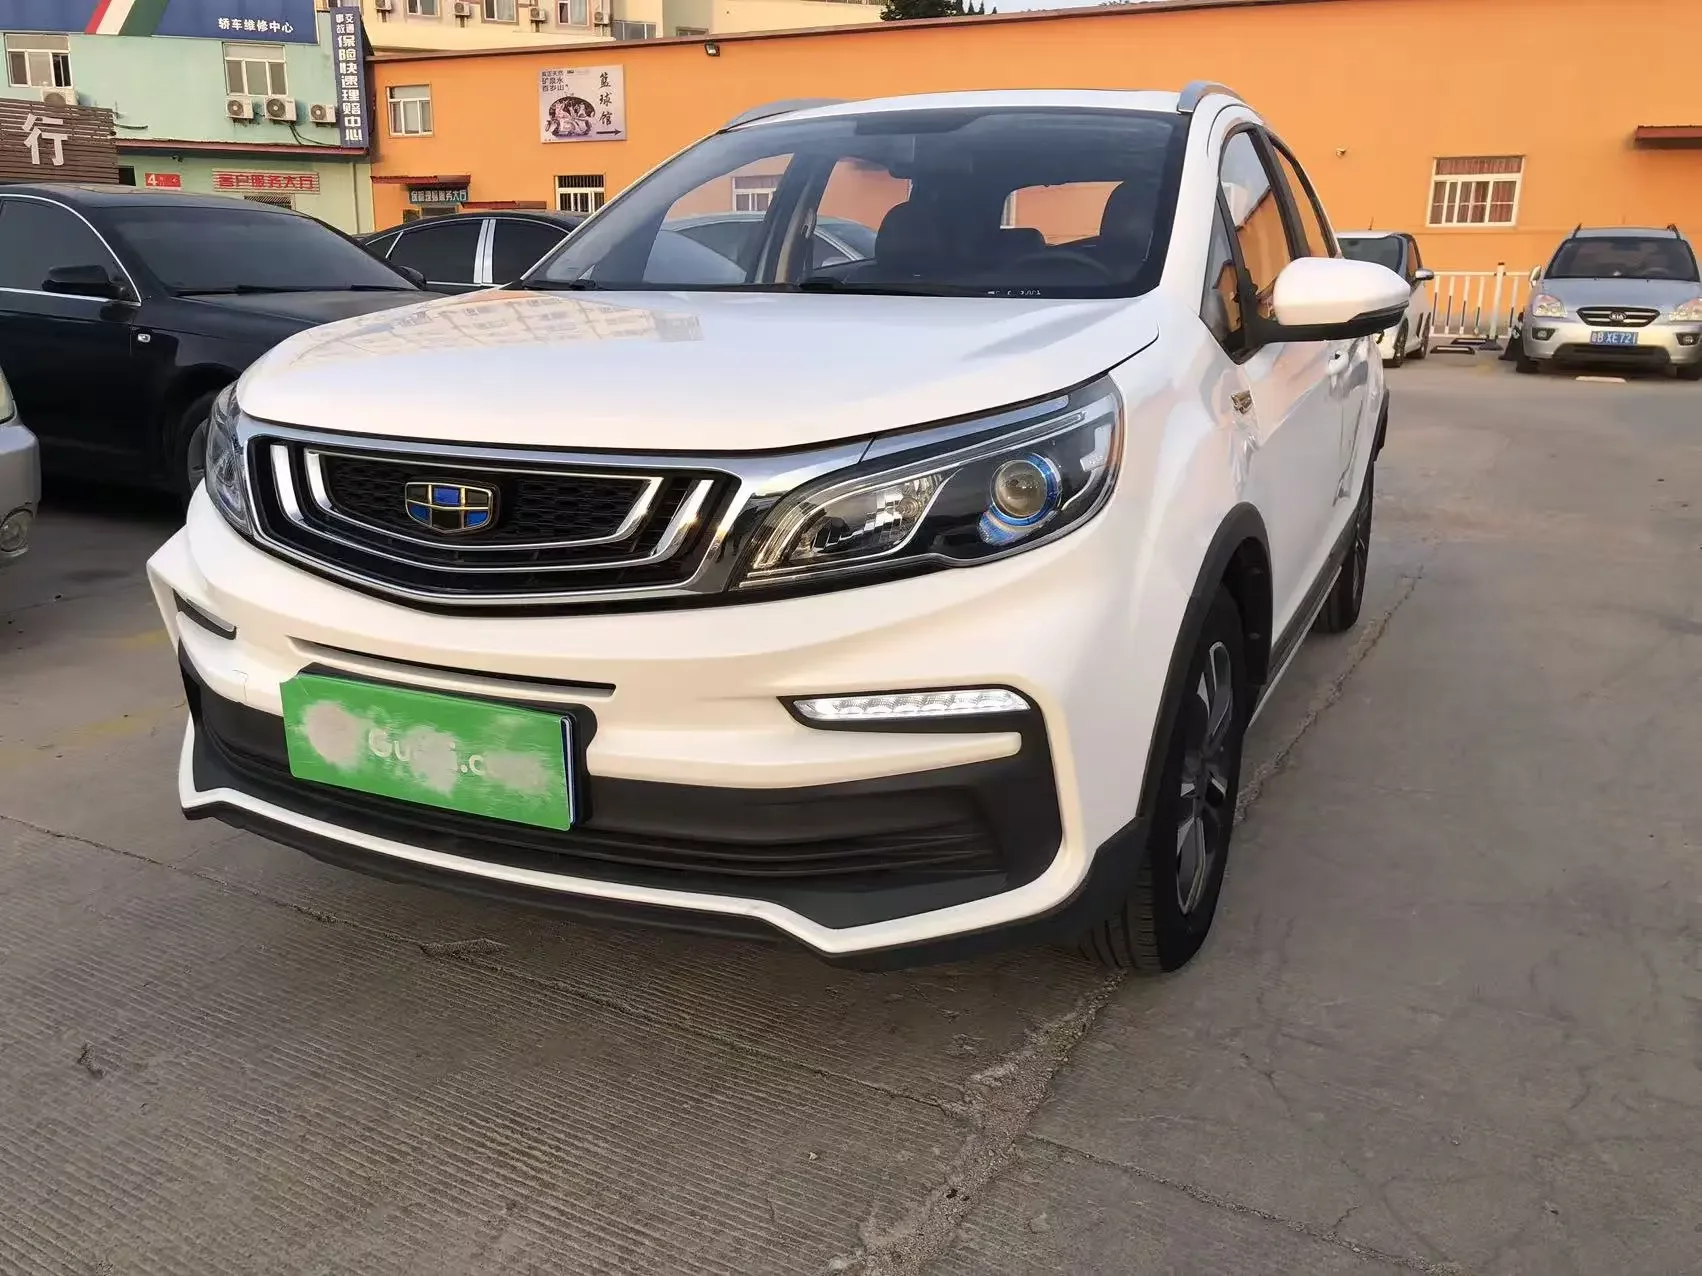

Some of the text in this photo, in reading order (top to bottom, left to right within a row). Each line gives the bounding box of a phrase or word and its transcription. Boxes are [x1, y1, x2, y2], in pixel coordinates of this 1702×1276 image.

[218, 17, 294, 34] 轿车维修中心
[337, 34, 363, 141] 保险快速理赔中心
[23, 113, 69, 167] 行
[147, 173, 158, 186] 4
[218, 173, 314, 190] 客户服务大厅
